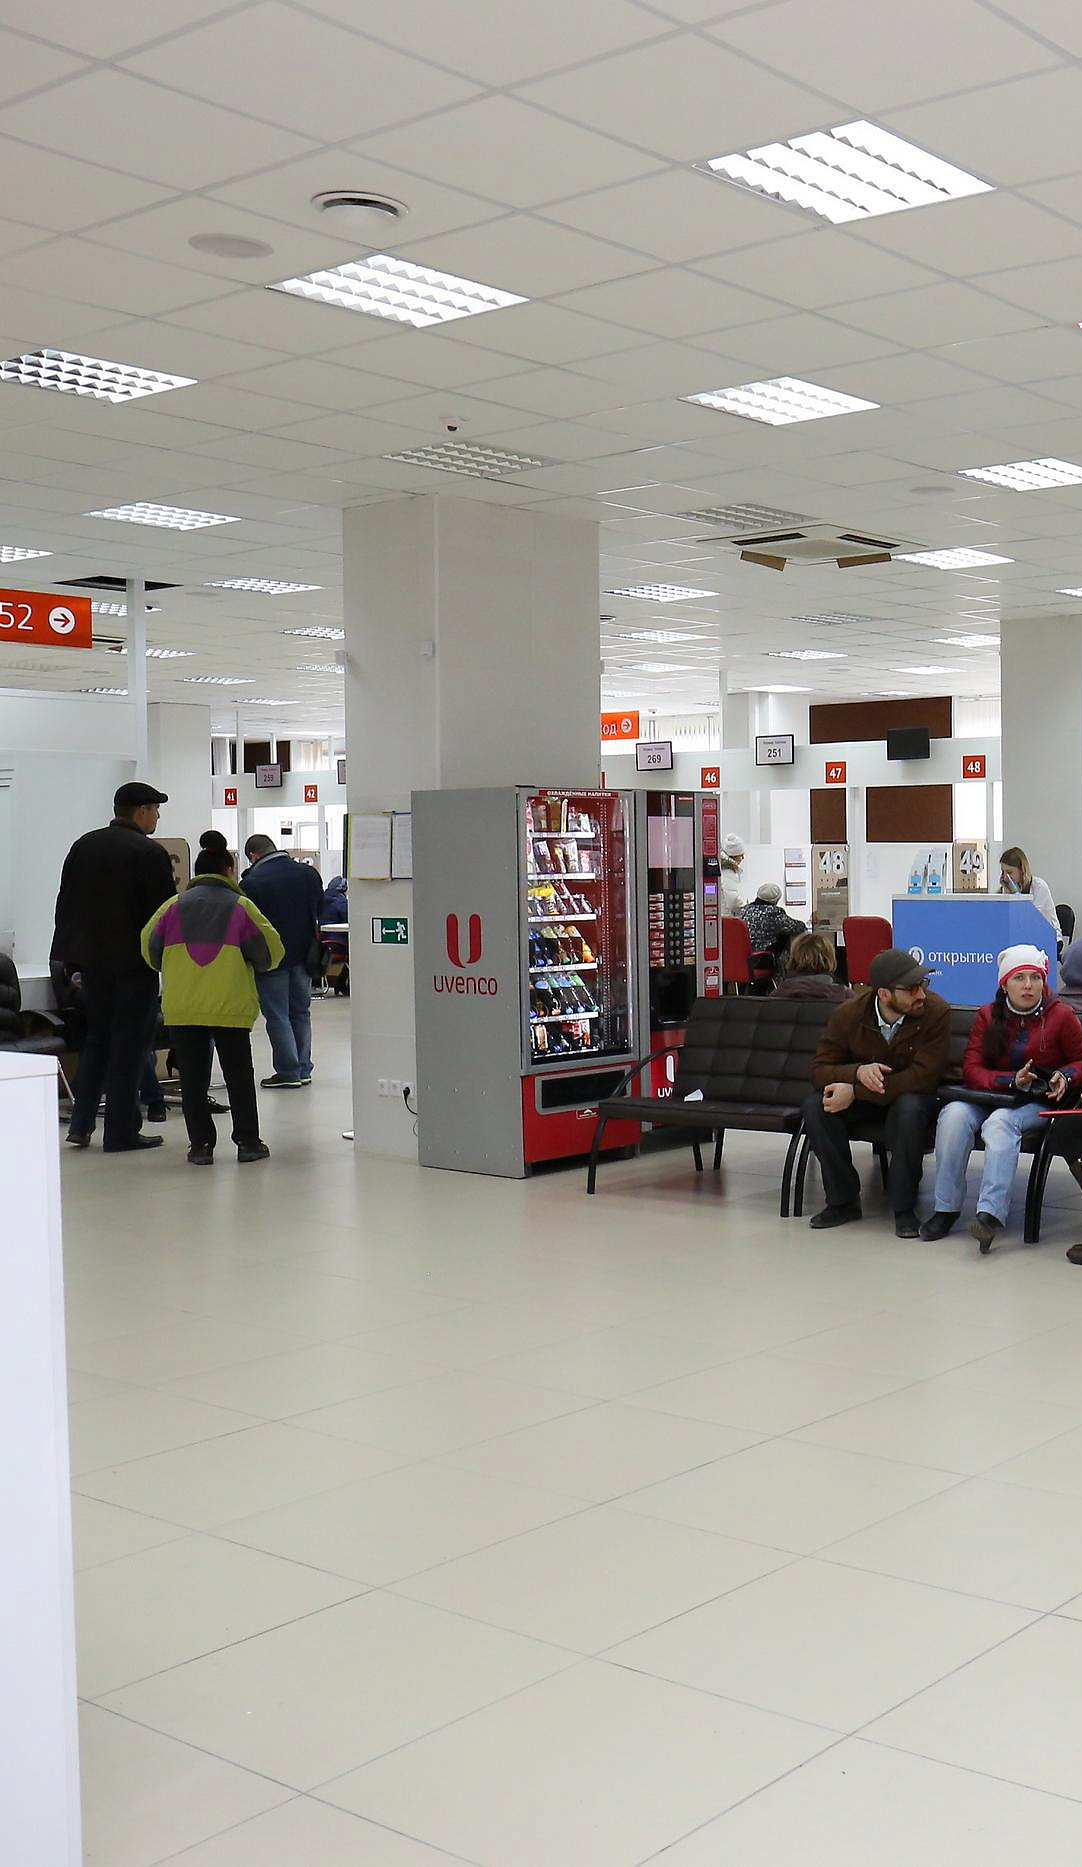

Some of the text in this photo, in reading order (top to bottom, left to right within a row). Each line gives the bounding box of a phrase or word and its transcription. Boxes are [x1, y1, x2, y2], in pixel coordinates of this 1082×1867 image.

[0, 601, 33, 630] 52
[647, 754, 662, 764] 269
[767, 748, 782, 758] 251
[829, 767, 842, 779] 47
[966, 761, 981, 773] 48
[705, 772, 717, 783] 46
[226, 792, 235, 801] 41
[306, 788, 316, 799] 42
[819, 850, 845, 874] 48
[959, 849, 985, 875] 49
[928, 951, 994, 966] открытие
[433, 975, 498, 995] uvenco
